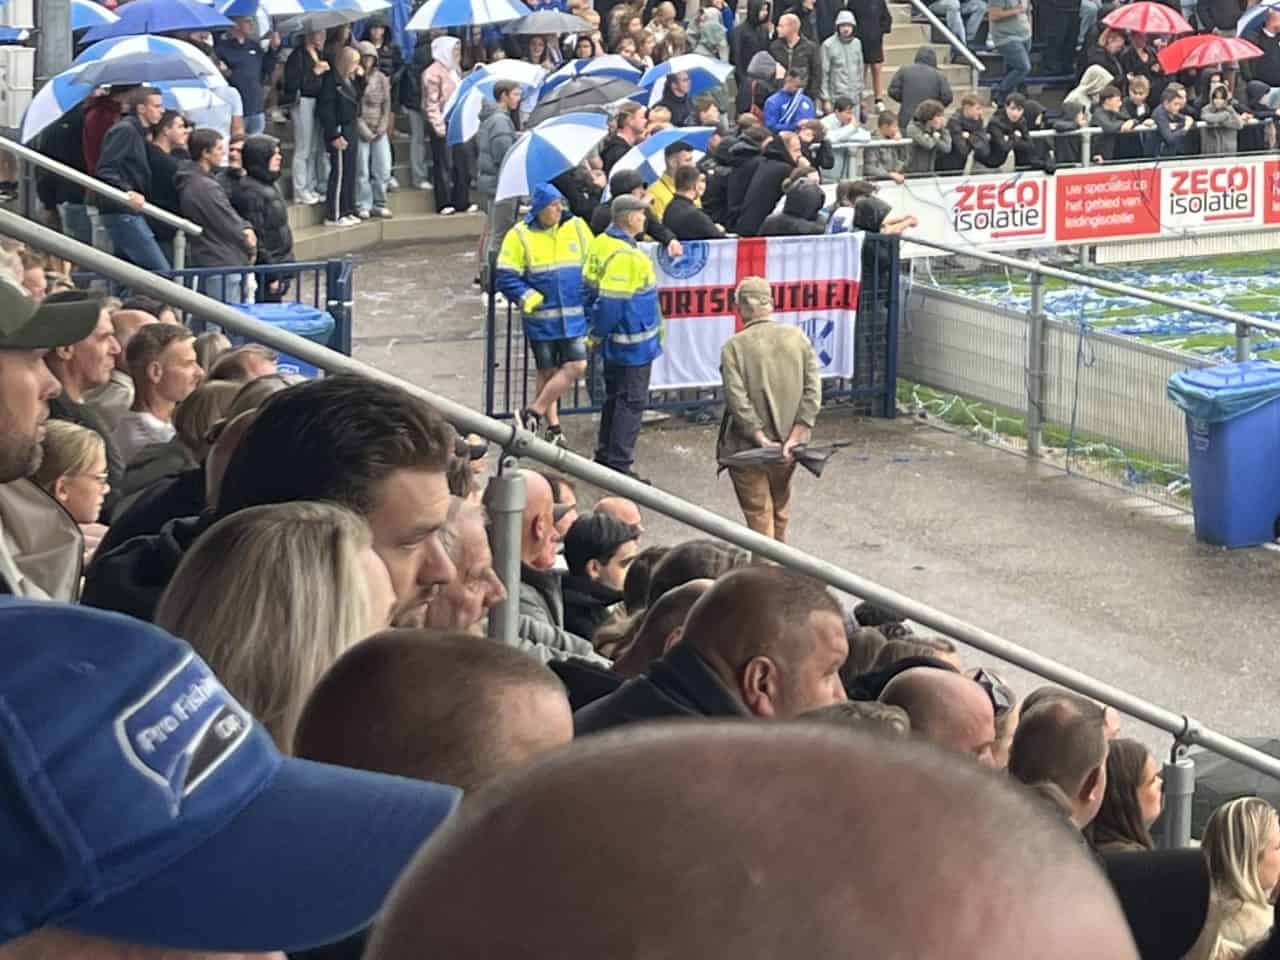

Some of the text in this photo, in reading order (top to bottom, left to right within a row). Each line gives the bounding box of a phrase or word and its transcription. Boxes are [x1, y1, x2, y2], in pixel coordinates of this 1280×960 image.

[953, 180, 1040, 211] ZECO
[1170, 166, 1249, 196] ZECO
[1169, 188, 1249, 215] isolatie
[953, 203, 1039, 233] isolatie
